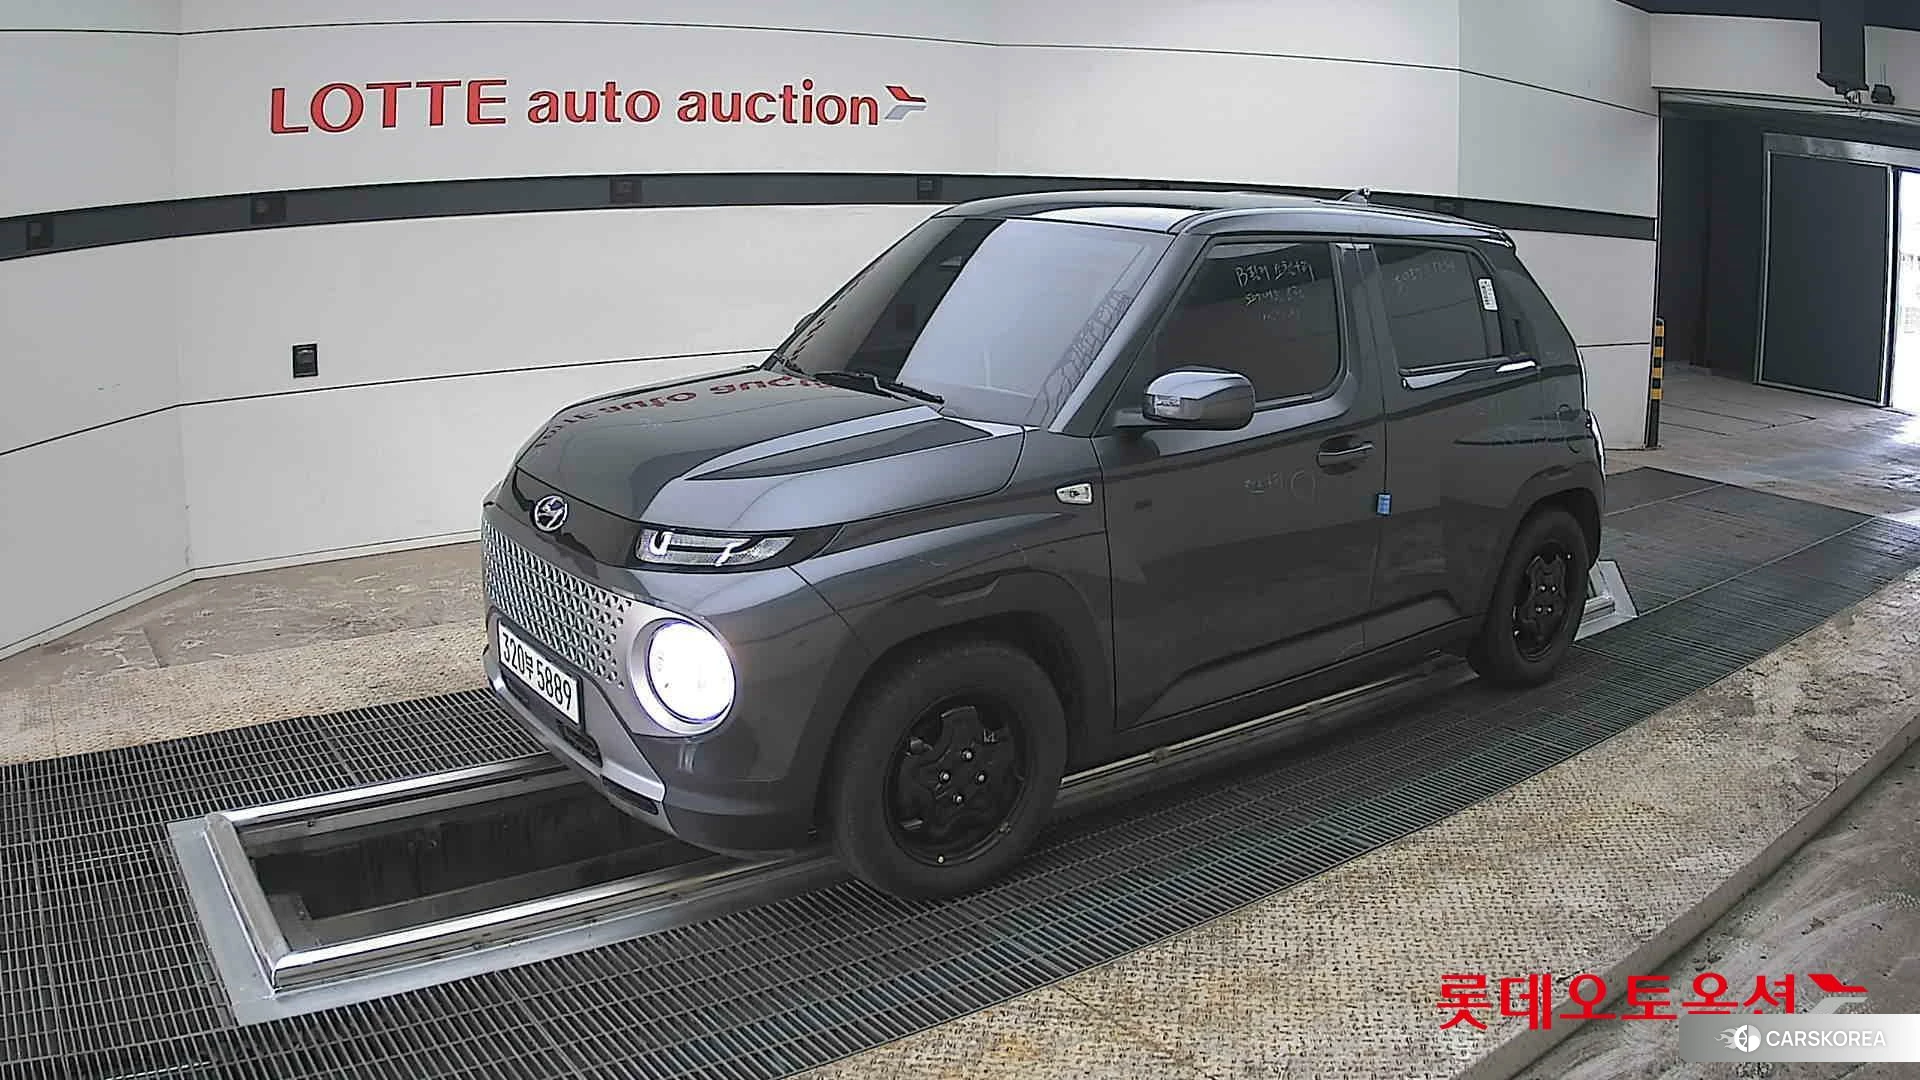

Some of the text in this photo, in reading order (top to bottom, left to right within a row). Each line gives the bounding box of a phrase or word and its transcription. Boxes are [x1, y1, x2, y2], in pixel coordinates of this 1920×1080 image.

[270, 79, 879, 134] LOTTE auto auction
[536, 658, 572, 712] 5889
